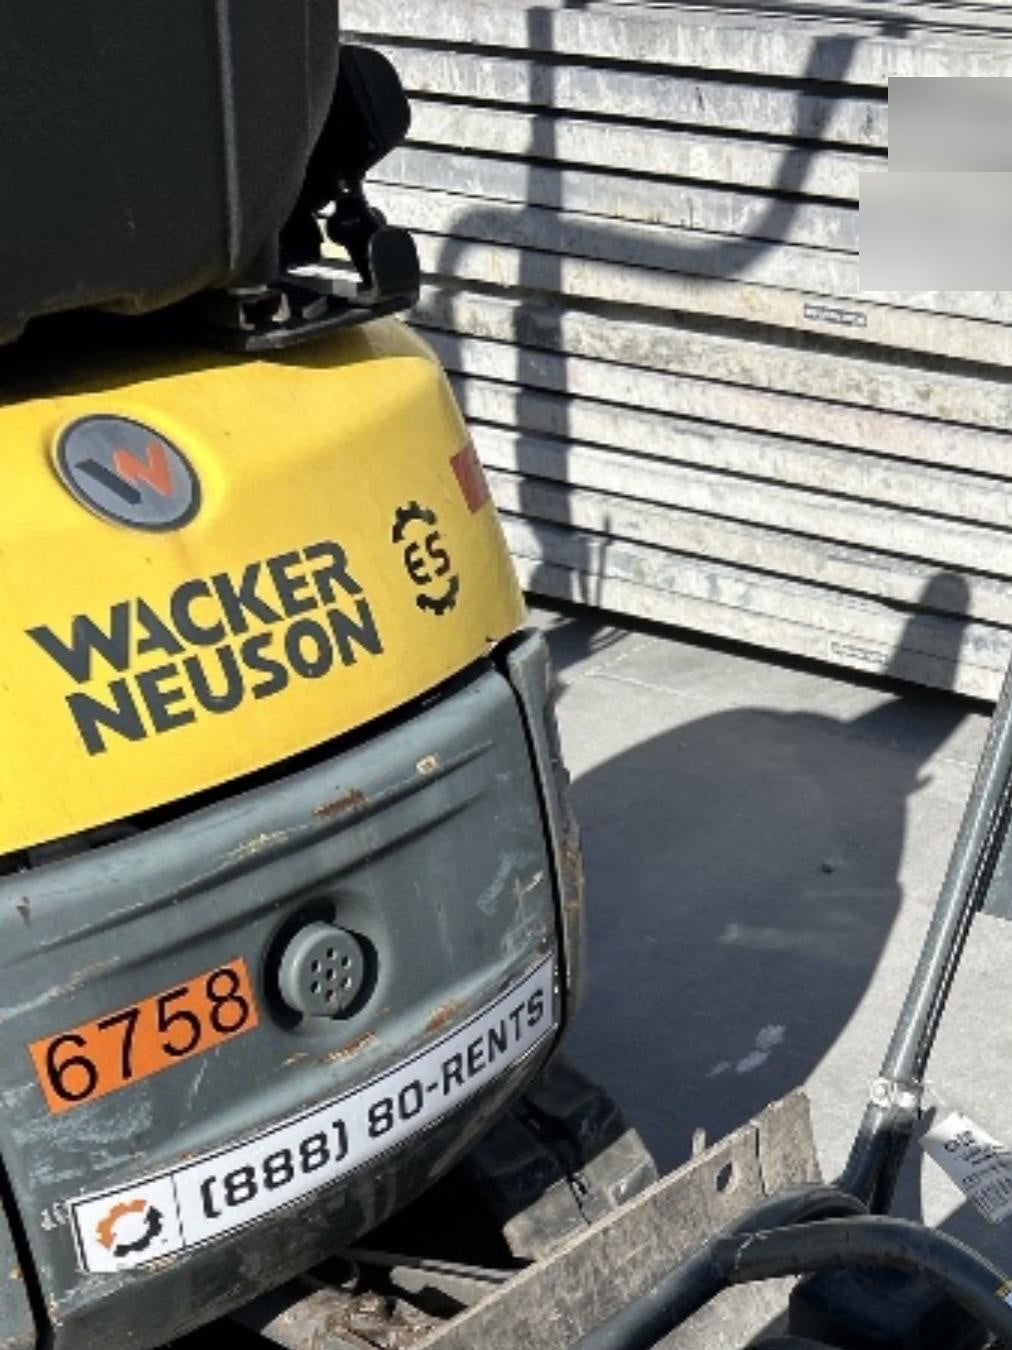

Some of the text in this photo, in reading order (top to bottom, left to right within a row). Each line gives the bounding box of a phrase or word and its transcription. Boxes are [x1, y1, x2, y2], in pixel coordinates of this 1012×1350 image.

[24, 540, 364, 684] WACKER
[65, 597, 384, 756] NEUSON
[46, 968, 250, 1103] 6758
[200, 988, 546, 1219] (888) 80-RENTS
